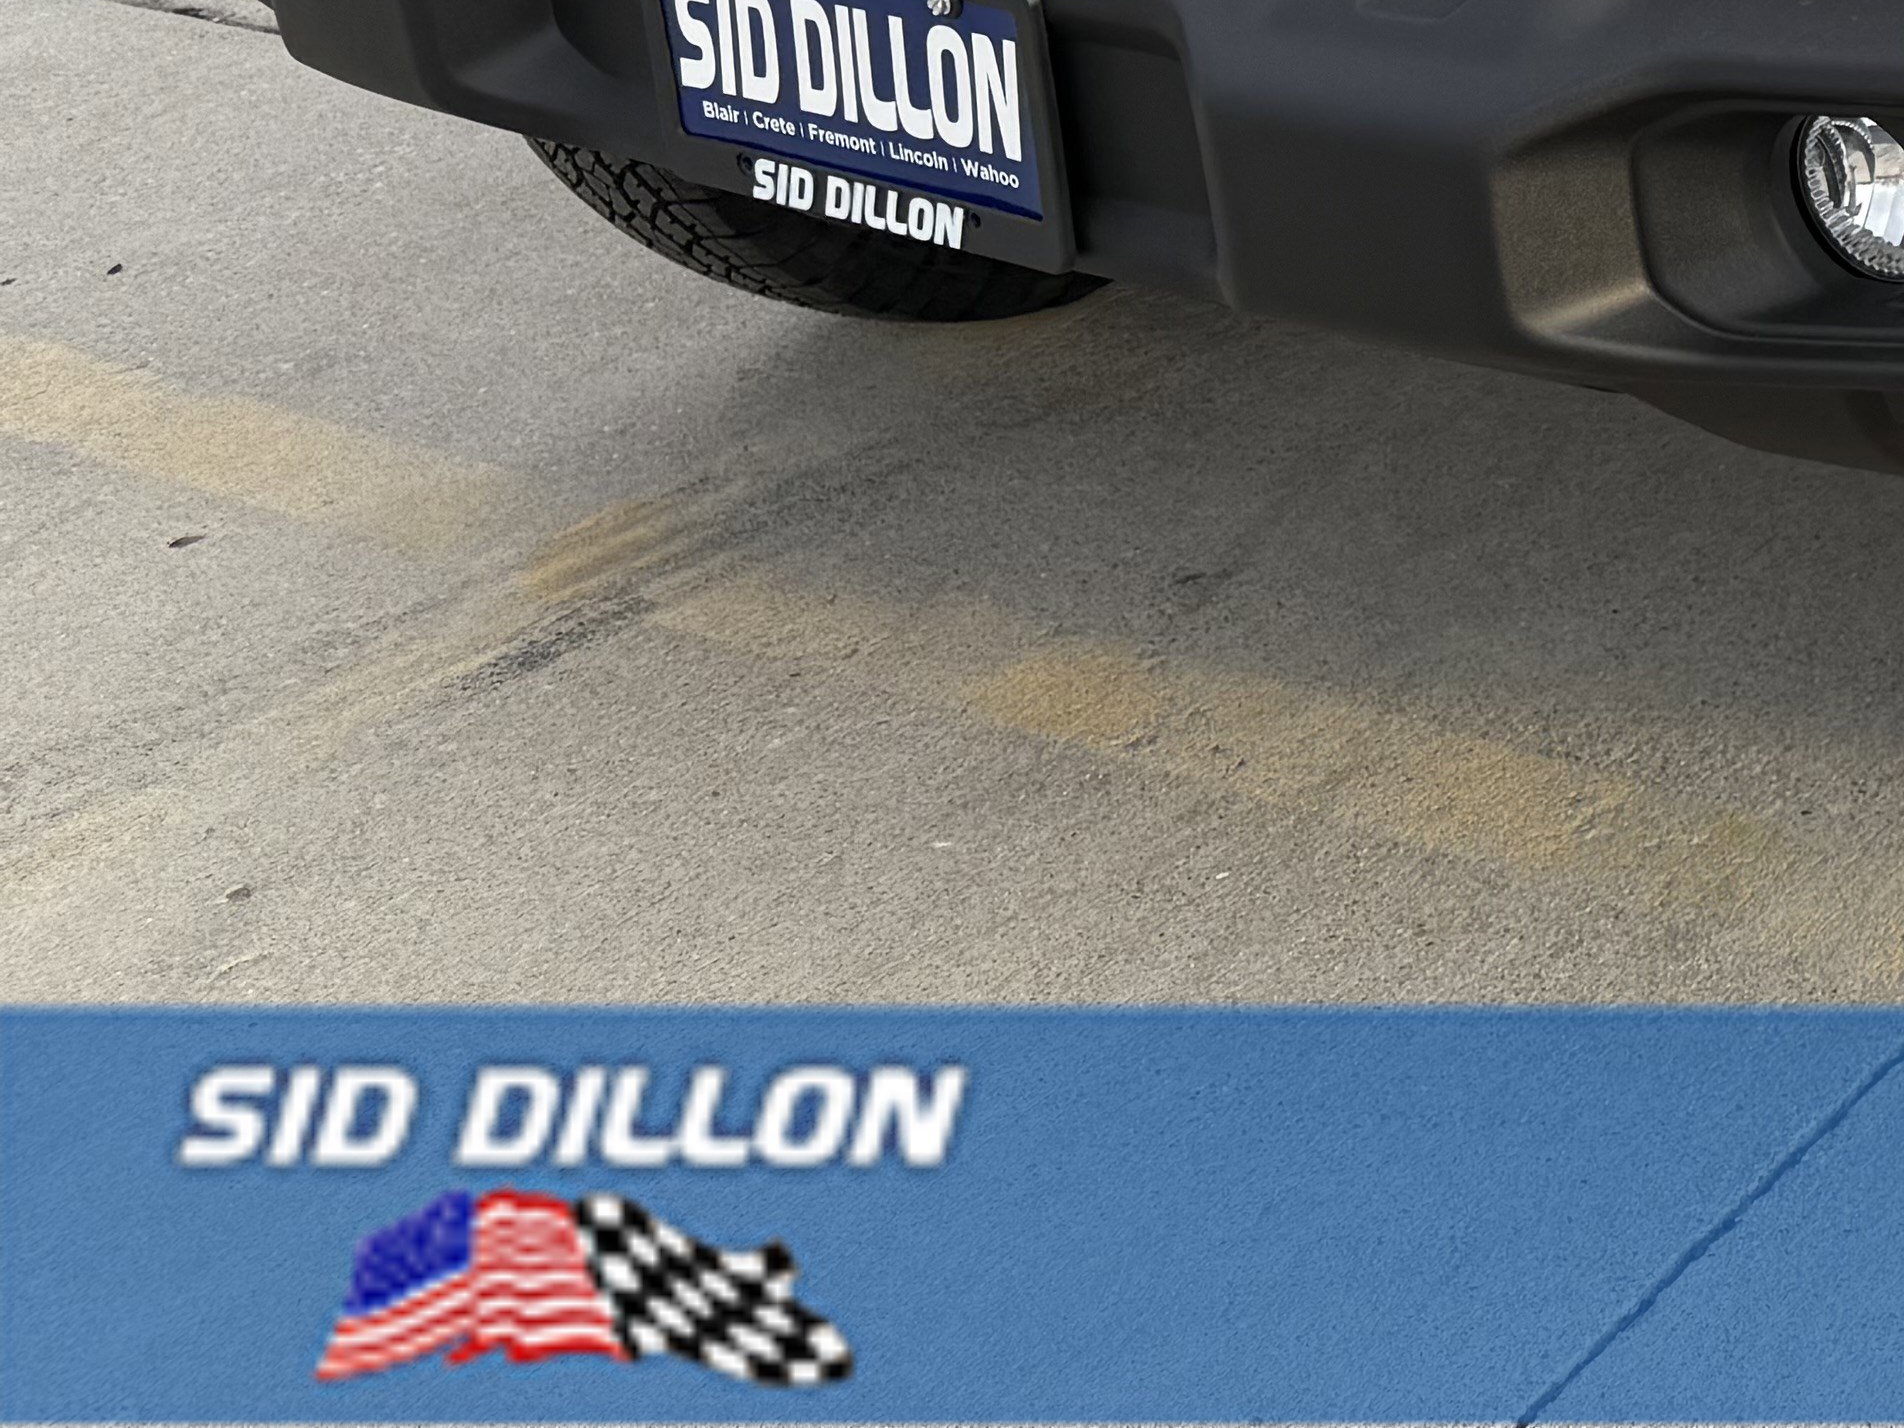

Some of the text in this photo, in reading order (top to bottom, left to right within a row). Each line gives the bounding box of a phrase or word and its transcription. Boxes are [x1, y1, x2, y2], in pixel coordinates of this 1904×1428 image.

[702, 99, 1020, 190] Blair Crete Fremont Lincoln Wahoo
[752, 157, 965, 251] SID DILLON
